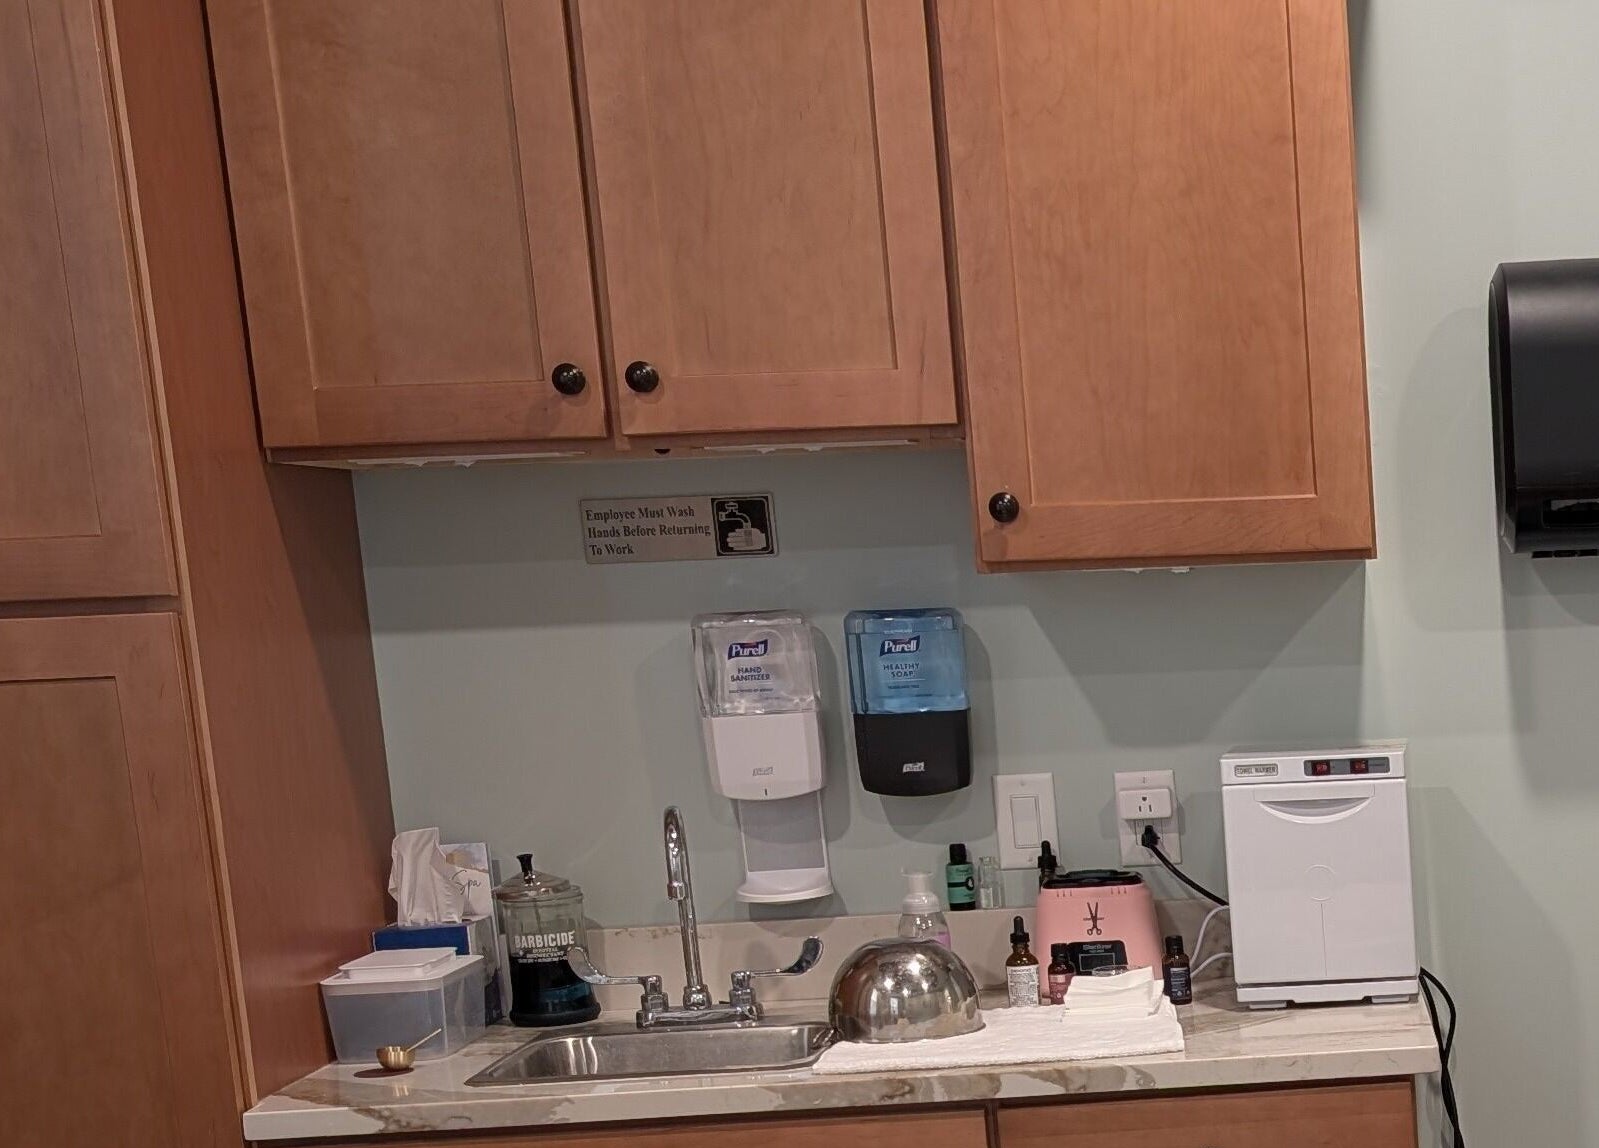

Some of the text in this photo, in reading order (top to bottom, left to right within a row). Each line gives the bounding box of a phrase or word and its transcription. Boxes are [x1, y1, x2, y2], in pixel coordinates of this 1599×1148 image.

[585, 506, 695, 523] Employee Must Wash
[587, 523, 711, 539] Hands Before Returning
[589, 543, 634, 556] To Work
[737, 666, 762, 674] HAND
[883, 662, 920, 671] HEALTHY
[730, 673, 771, 682] SANITIZER
[890, 670, 914, 678] SOAP
[451, 869, 482, 898] Spa
[514, 929, 576, 948] BARBICIDE
